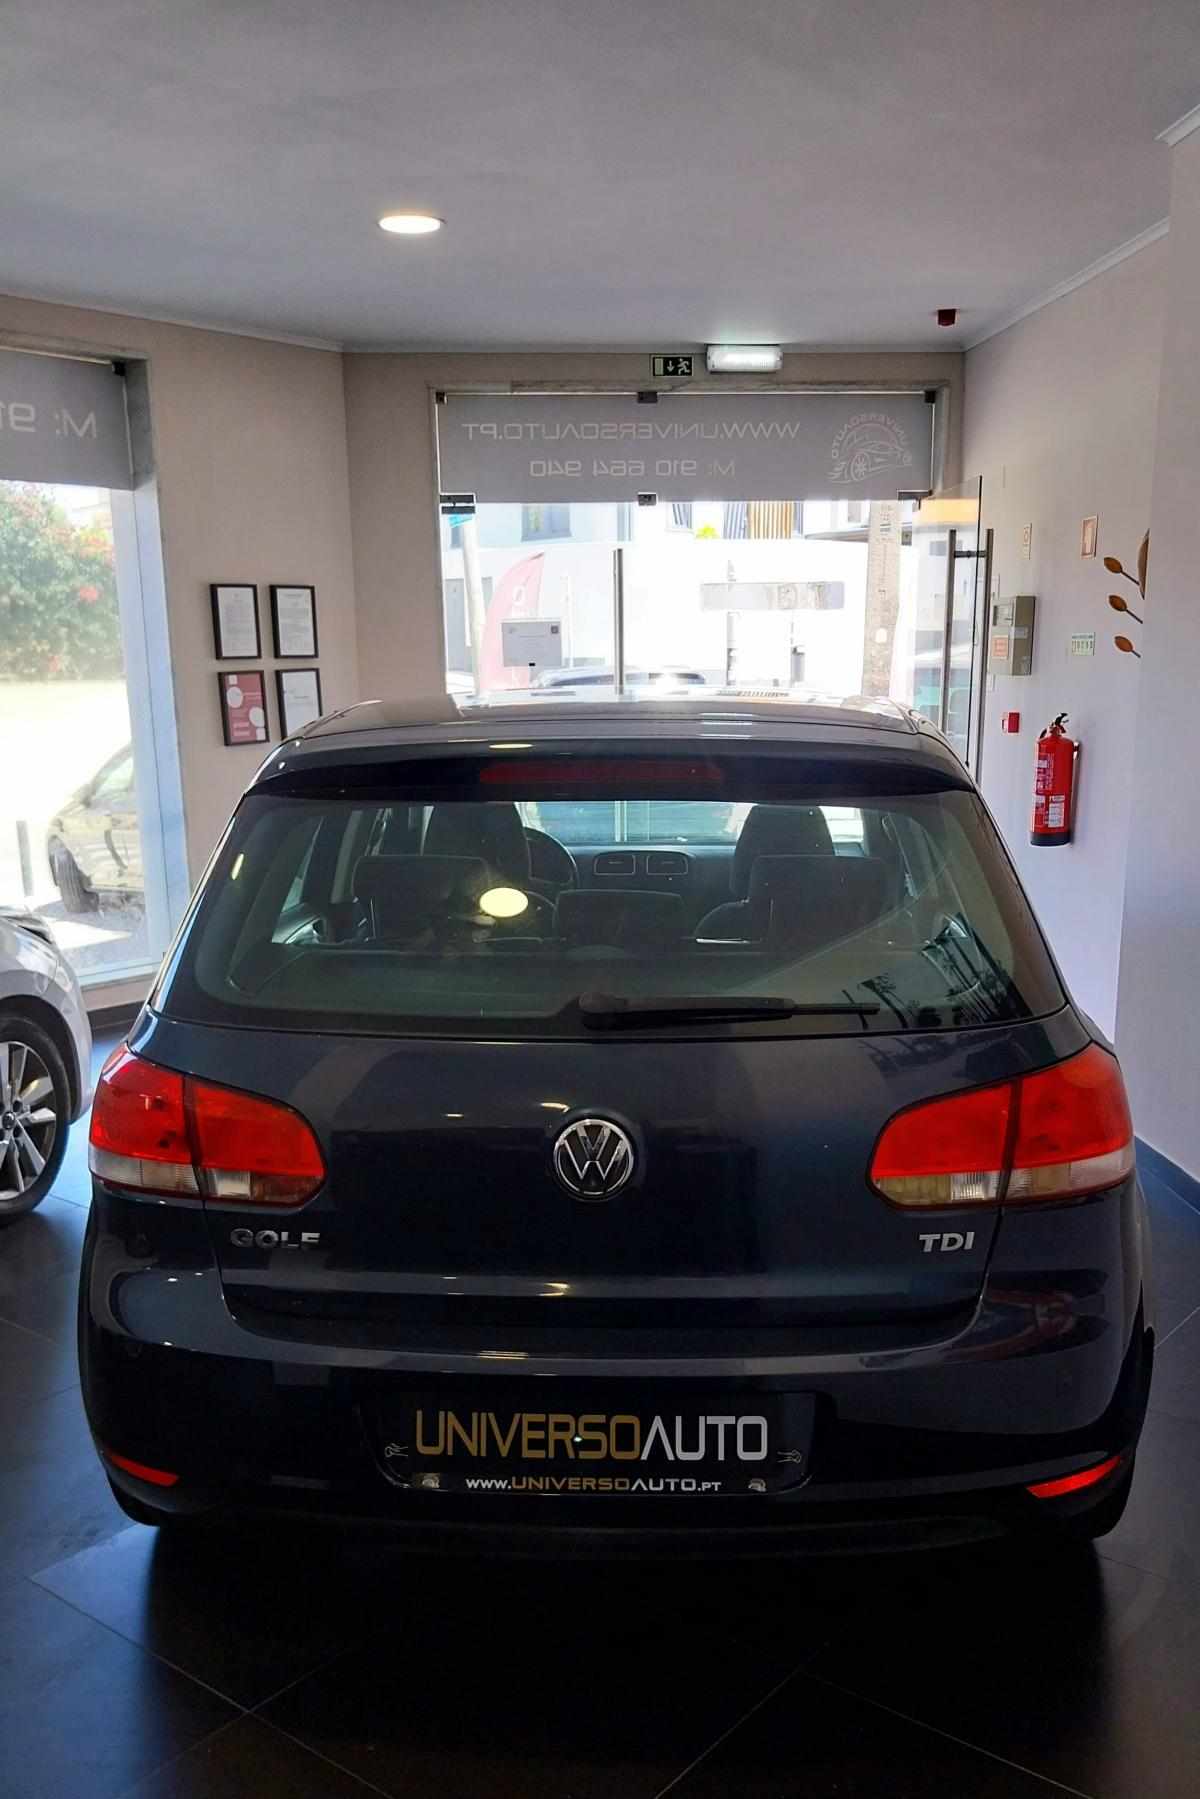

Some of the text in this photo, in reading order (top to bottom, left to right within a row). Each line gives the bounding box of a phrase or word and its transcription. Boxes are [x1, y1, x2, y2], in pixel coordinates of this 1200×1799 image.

[230, 1228, 320, 1250] GOLF
[919, 1231, 975, 1253] TDI
[415, 1410, 769, 1461] UNIVERSOAUTO
[465, 1475, 722, 1492] www.UNIVERSOAUTO.PT
